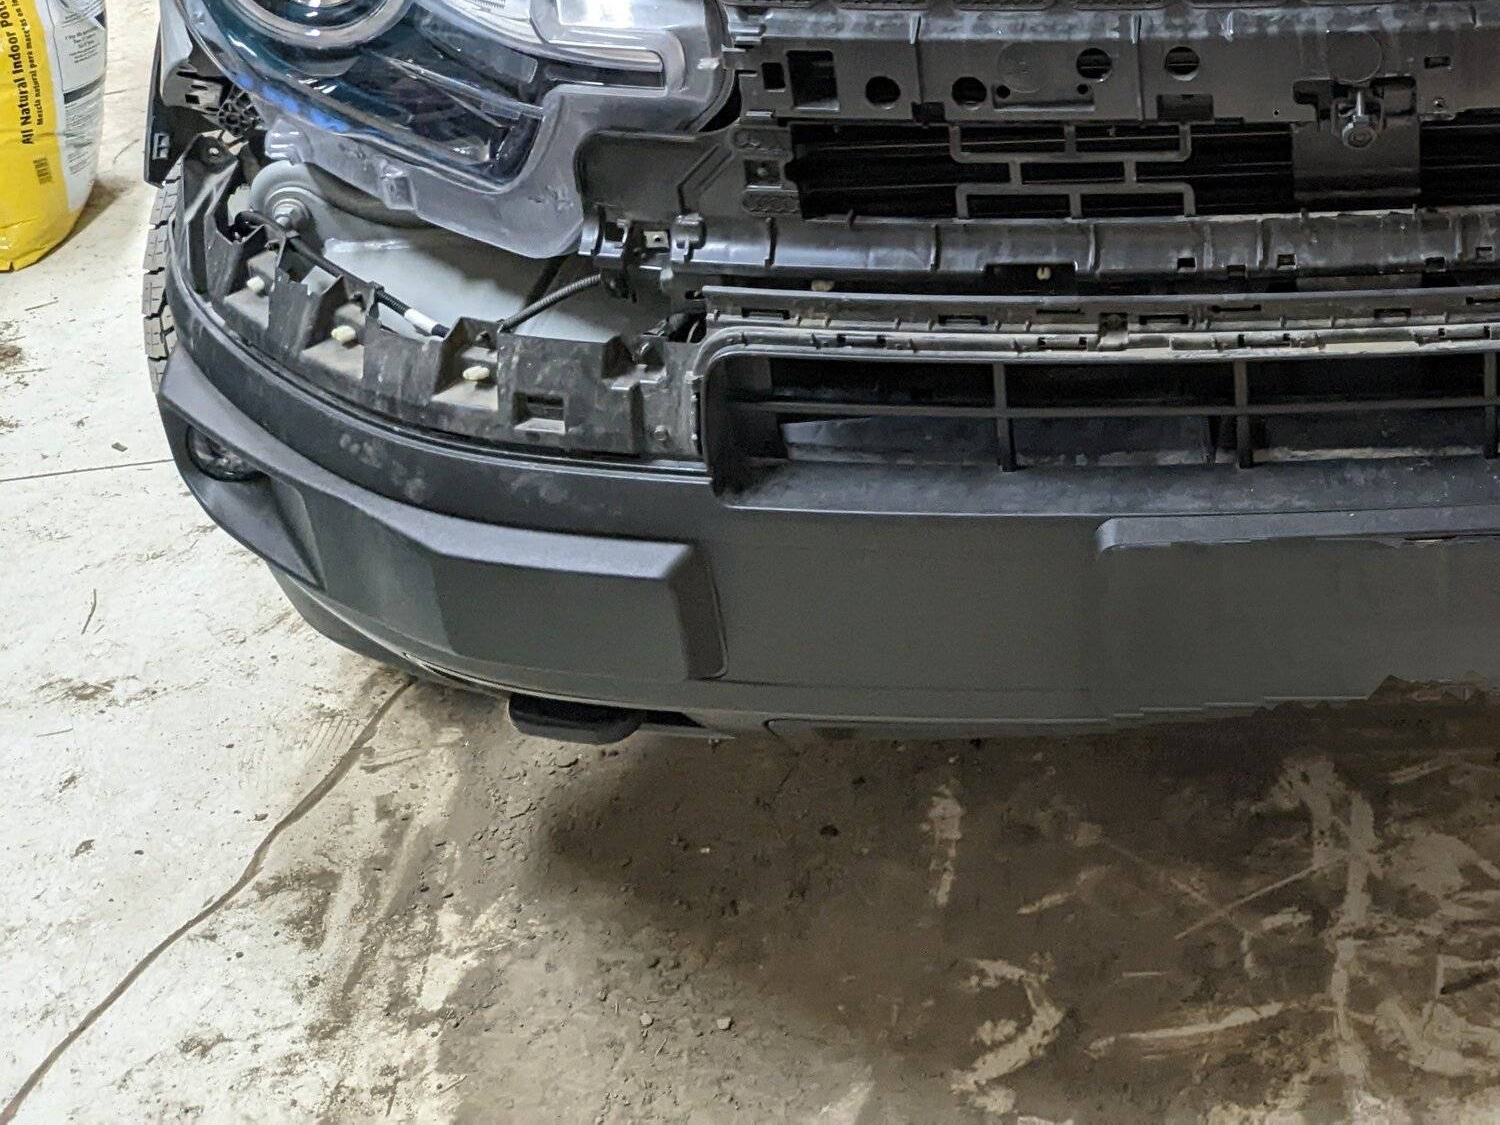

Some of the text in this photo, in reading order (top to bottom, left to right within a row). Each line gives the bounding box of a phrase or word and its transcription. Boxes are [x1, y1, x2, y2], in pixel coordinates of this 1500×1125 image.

[15, 8, 23, 17] en
[6, 31, 23, 74] Indoor
[26, 51, 37, 68] para
[29, 70, 40, 97] natural
[14, 77, 31, 126] Natural
[34, 99, 43, 125] Mezcla
[21, 129, 34, 144] All
